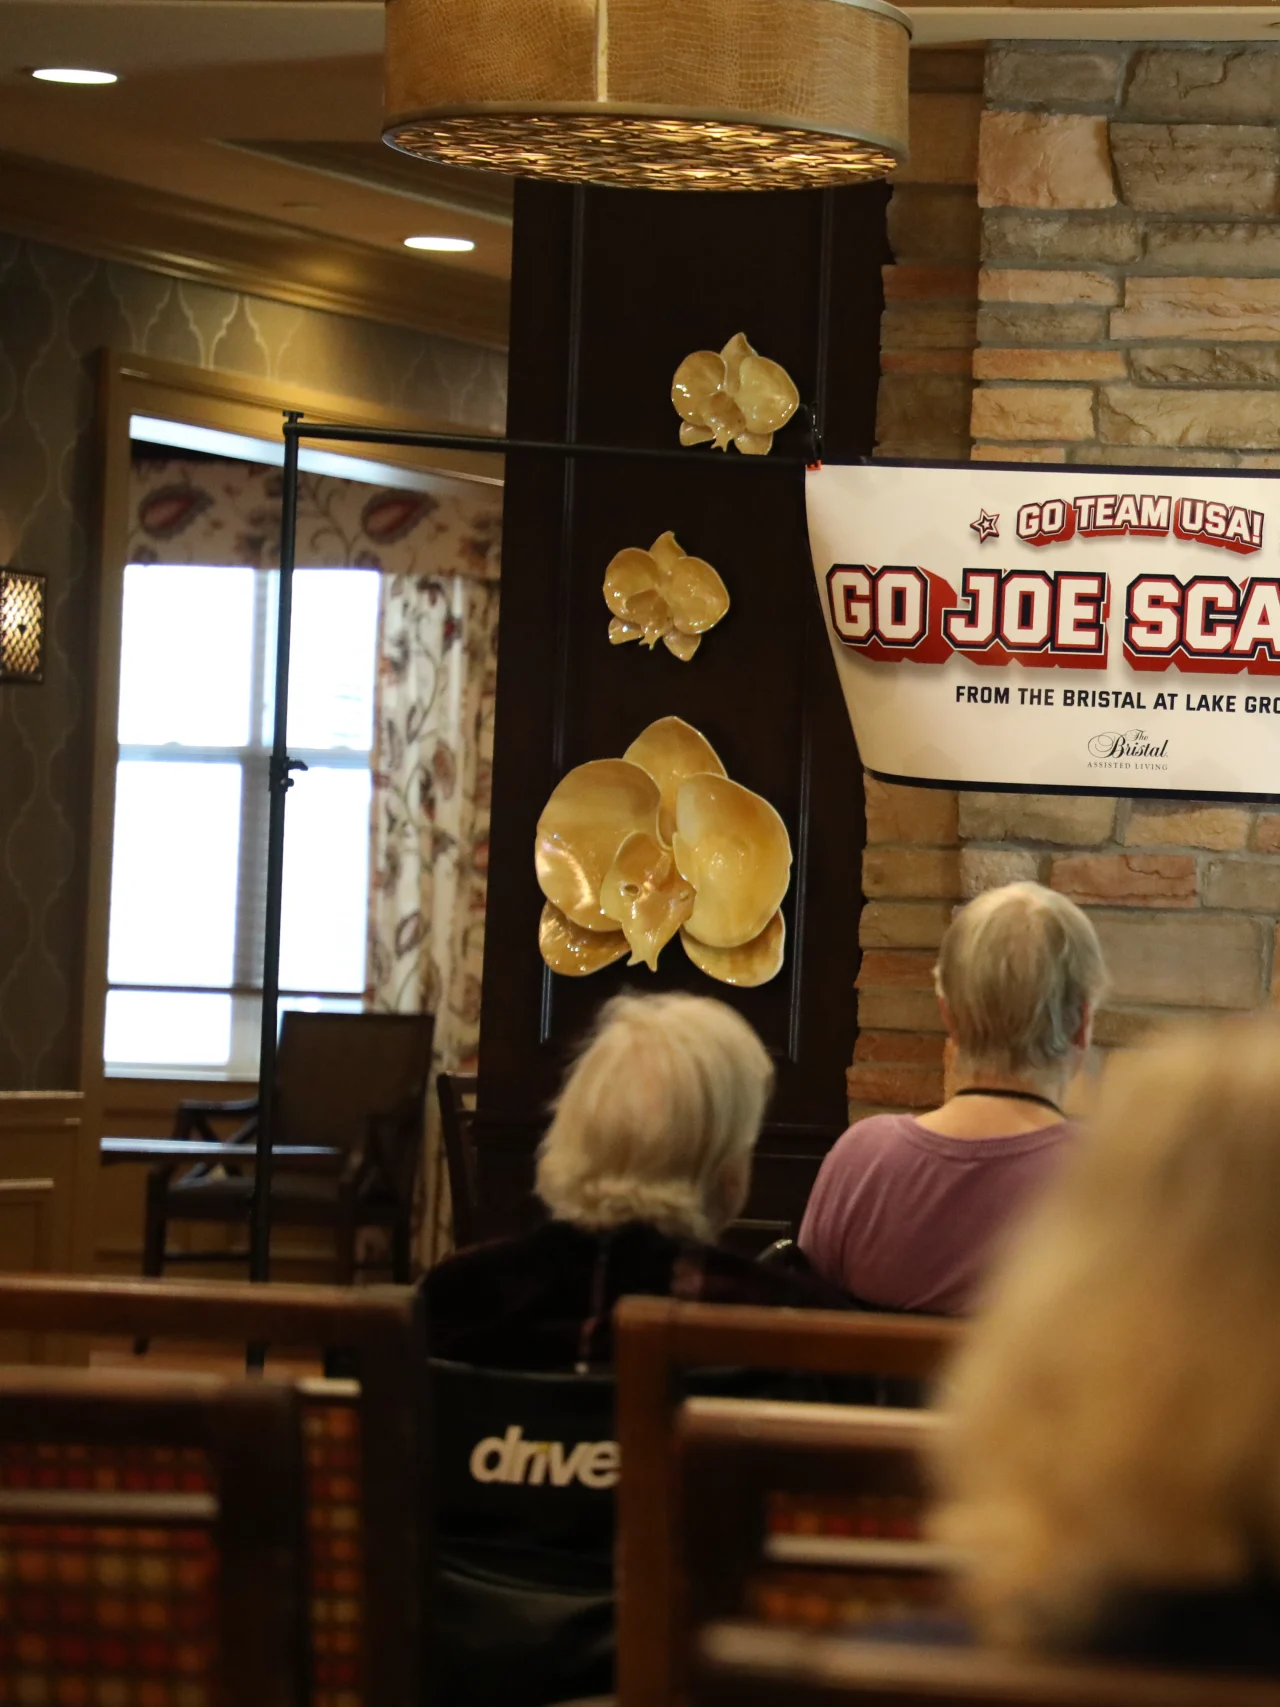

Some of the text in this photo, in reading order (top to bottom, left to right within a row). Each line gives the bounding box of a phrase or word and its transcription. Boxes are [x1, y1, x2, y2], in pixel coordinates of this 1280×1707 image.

[1016, 494, 1265, 549] GO TEAM USA!
[825, 563, 930, 650] GO
[942, 568, 1108, 656] JOE
[956, 685, 1010, 705] FROM
[1017, 687, 1054, 706] THE
[1063, 689, 1147, 710] BRISTAL
[1153, 693, 1178, 710] AT
[1185, 693, 1237, 713] LAKE
[1087, 731, 1169, 759] Bristal
[1125, 728, 1149, 741] The
[1086, 761, 1168, 771] ASSISTED LIVING
[469, 1424, 621, 1489] drive
